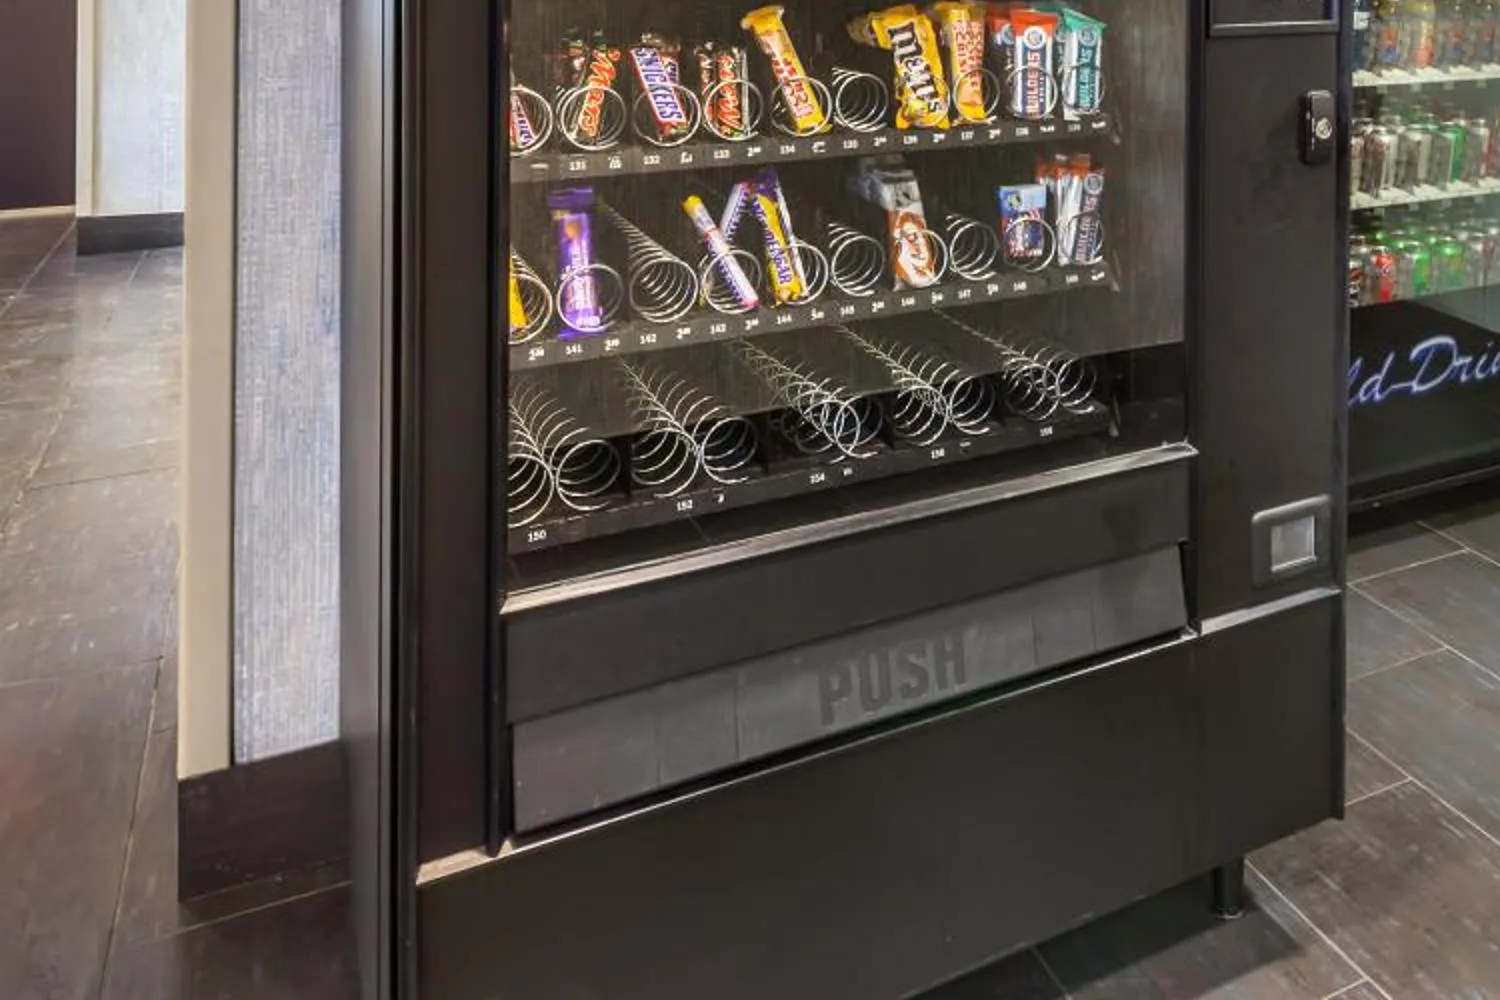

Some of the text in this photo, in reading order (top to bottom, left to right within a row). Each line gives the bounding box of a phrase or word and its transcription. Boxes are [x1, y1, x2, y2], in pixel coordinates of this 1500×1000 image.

[631, 47, 684, 122] SNICKERS
[1347, 351, 1395, 406] ld
[816, 633, 968, 727] PUSH
